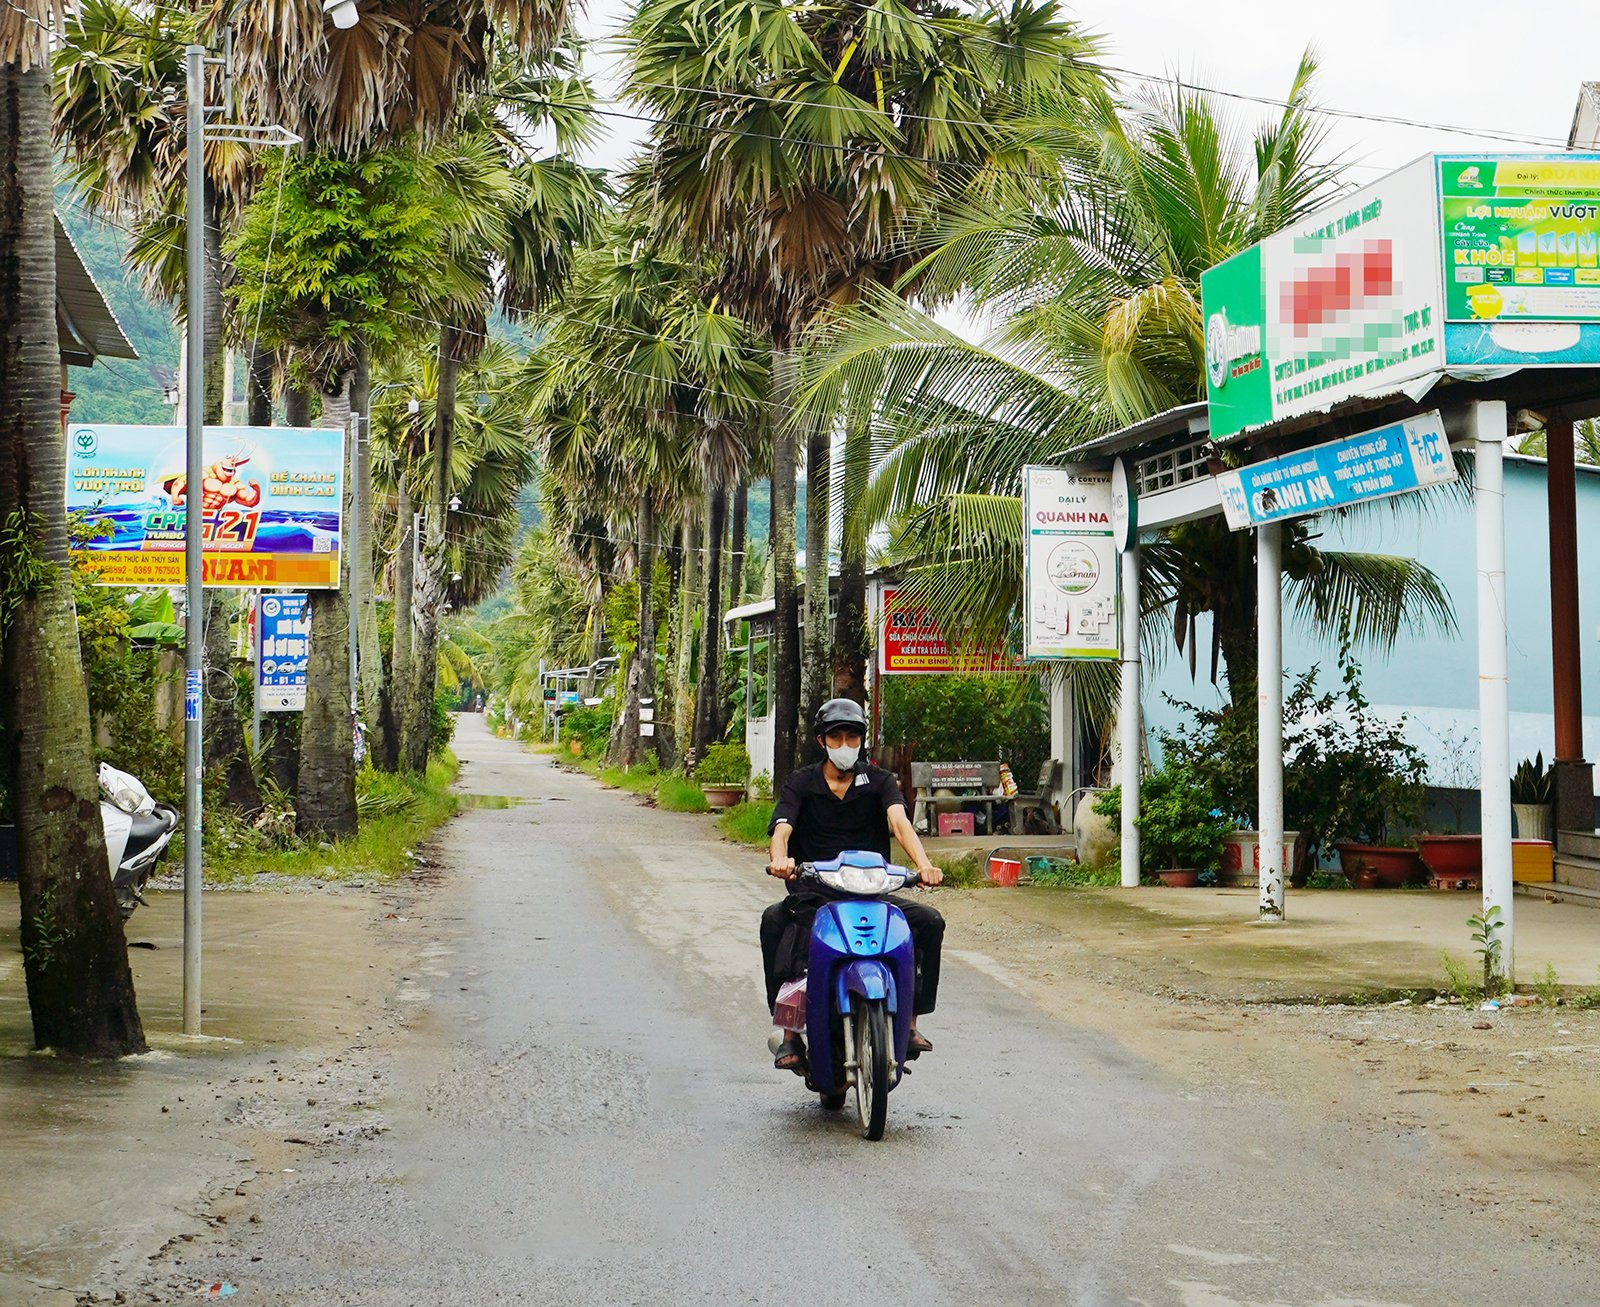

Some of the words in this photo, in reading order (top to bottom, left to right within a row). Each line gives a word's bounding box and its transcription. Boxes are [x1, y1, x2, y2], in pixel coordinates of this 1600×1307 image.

[1549, 204, 1597, 222] VƯỢT
[1306, 475, 1335, 502] NA
[1036, 511, 1086, 523] QUANH
[1088, 513, 1109, 523] NA
[917, 647, 929, 655] TRA
[263, 676, 273, 685] A1
[279, 677, 289, 685] B1
